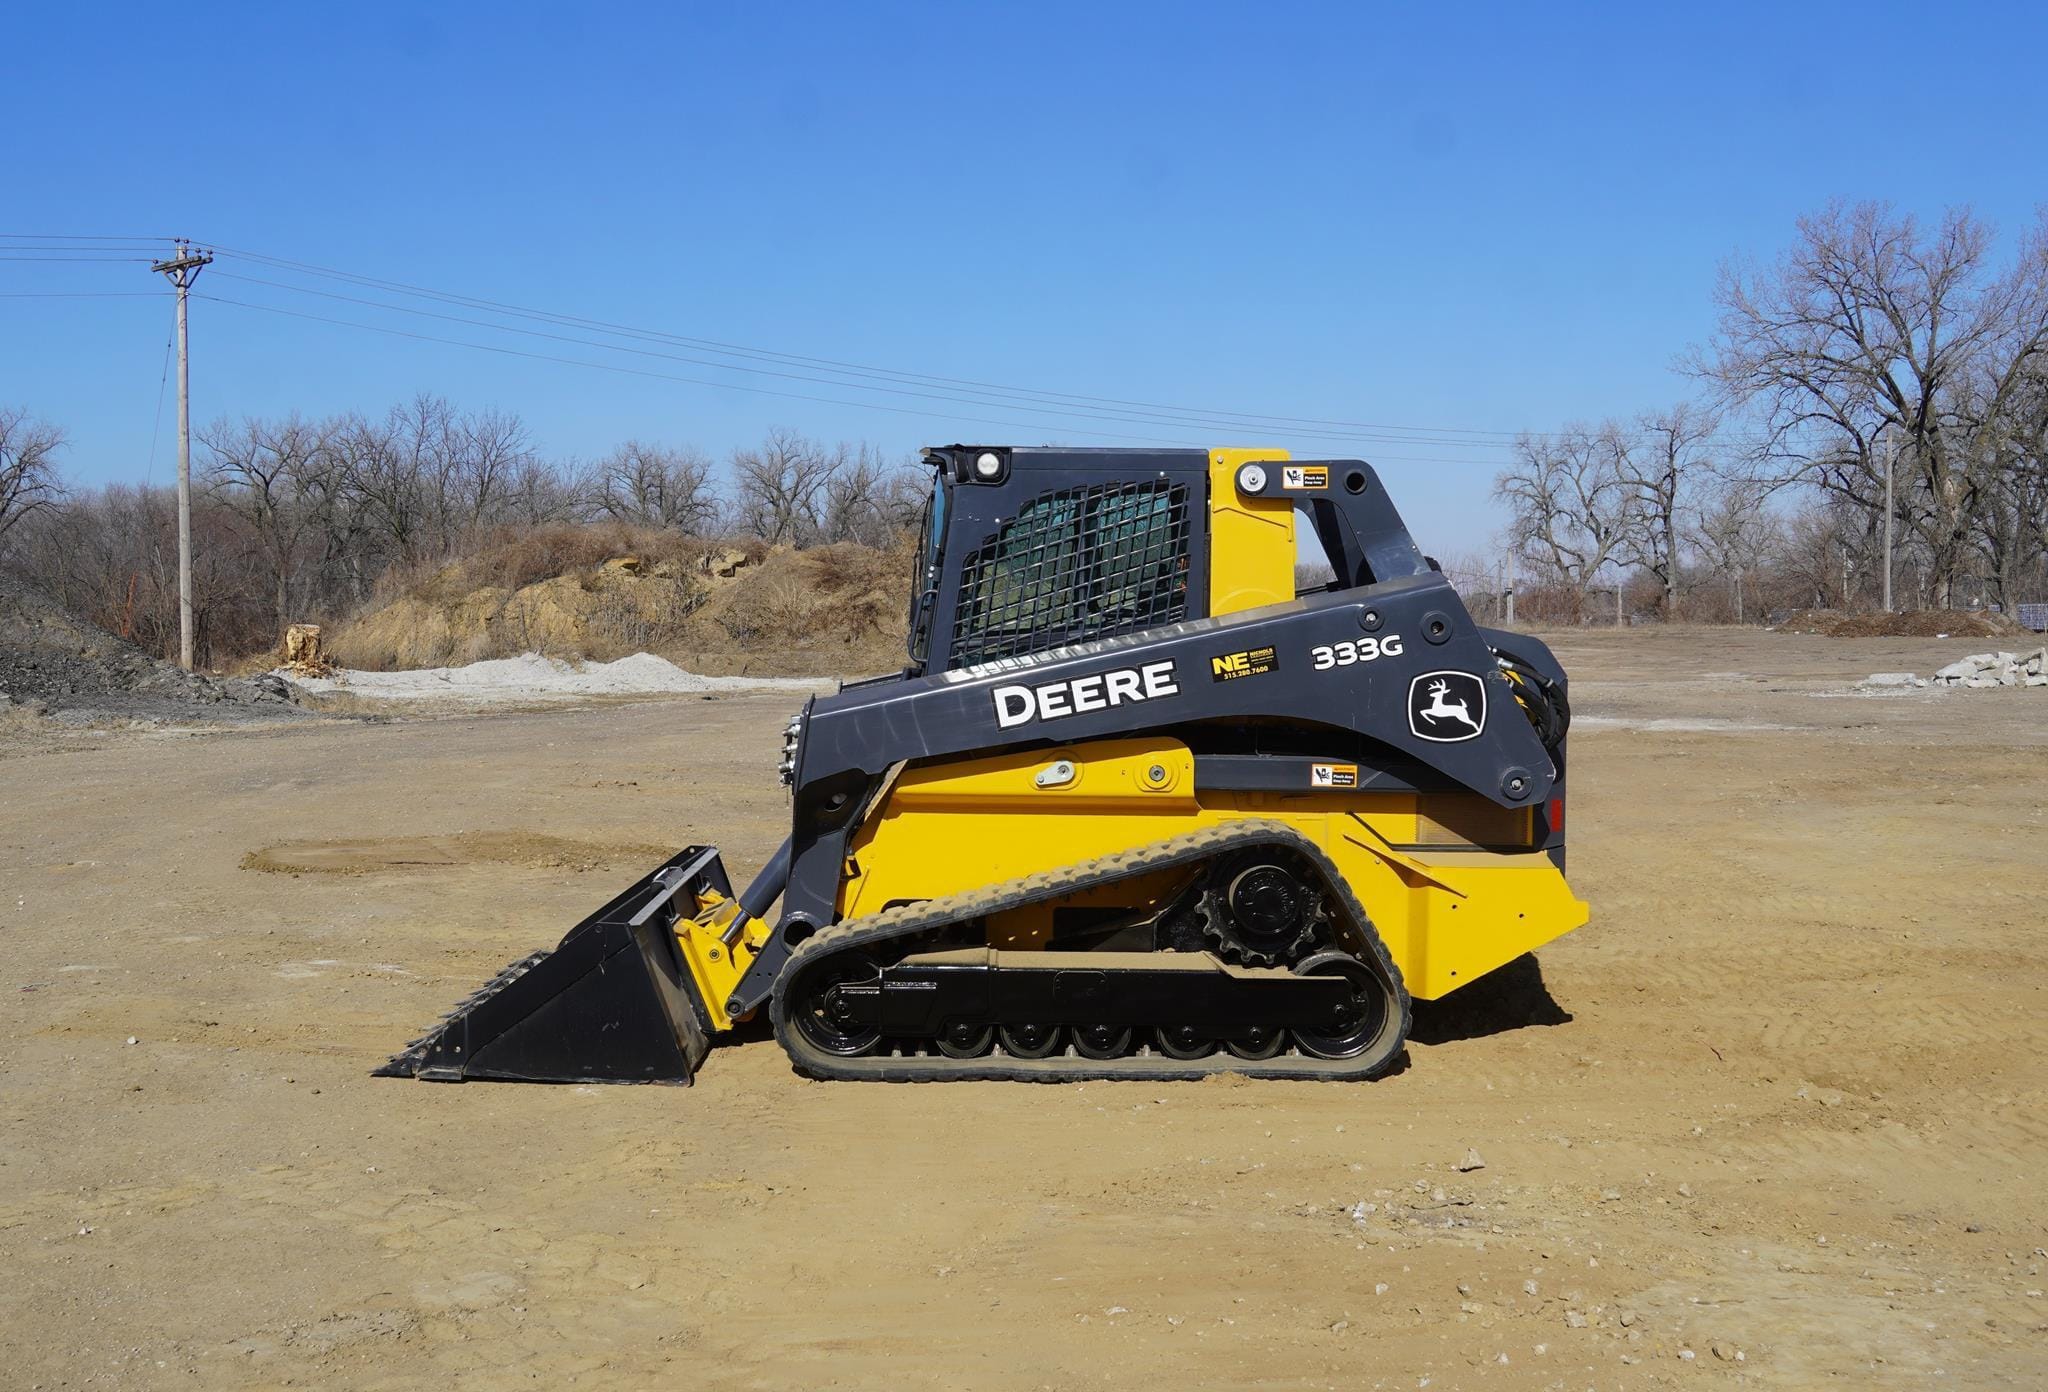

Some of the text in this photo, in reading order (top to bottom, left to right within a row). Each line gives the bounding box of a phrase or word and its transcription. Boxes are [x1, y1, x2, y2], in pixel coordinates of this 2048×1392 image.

[1212, 651, 1250, 675] NE
[1311, 634, 1404, 670] 333G
[1223, 665, 1269, 680] 515.280.7600
[993, 661, 1179, 728] DEERE
